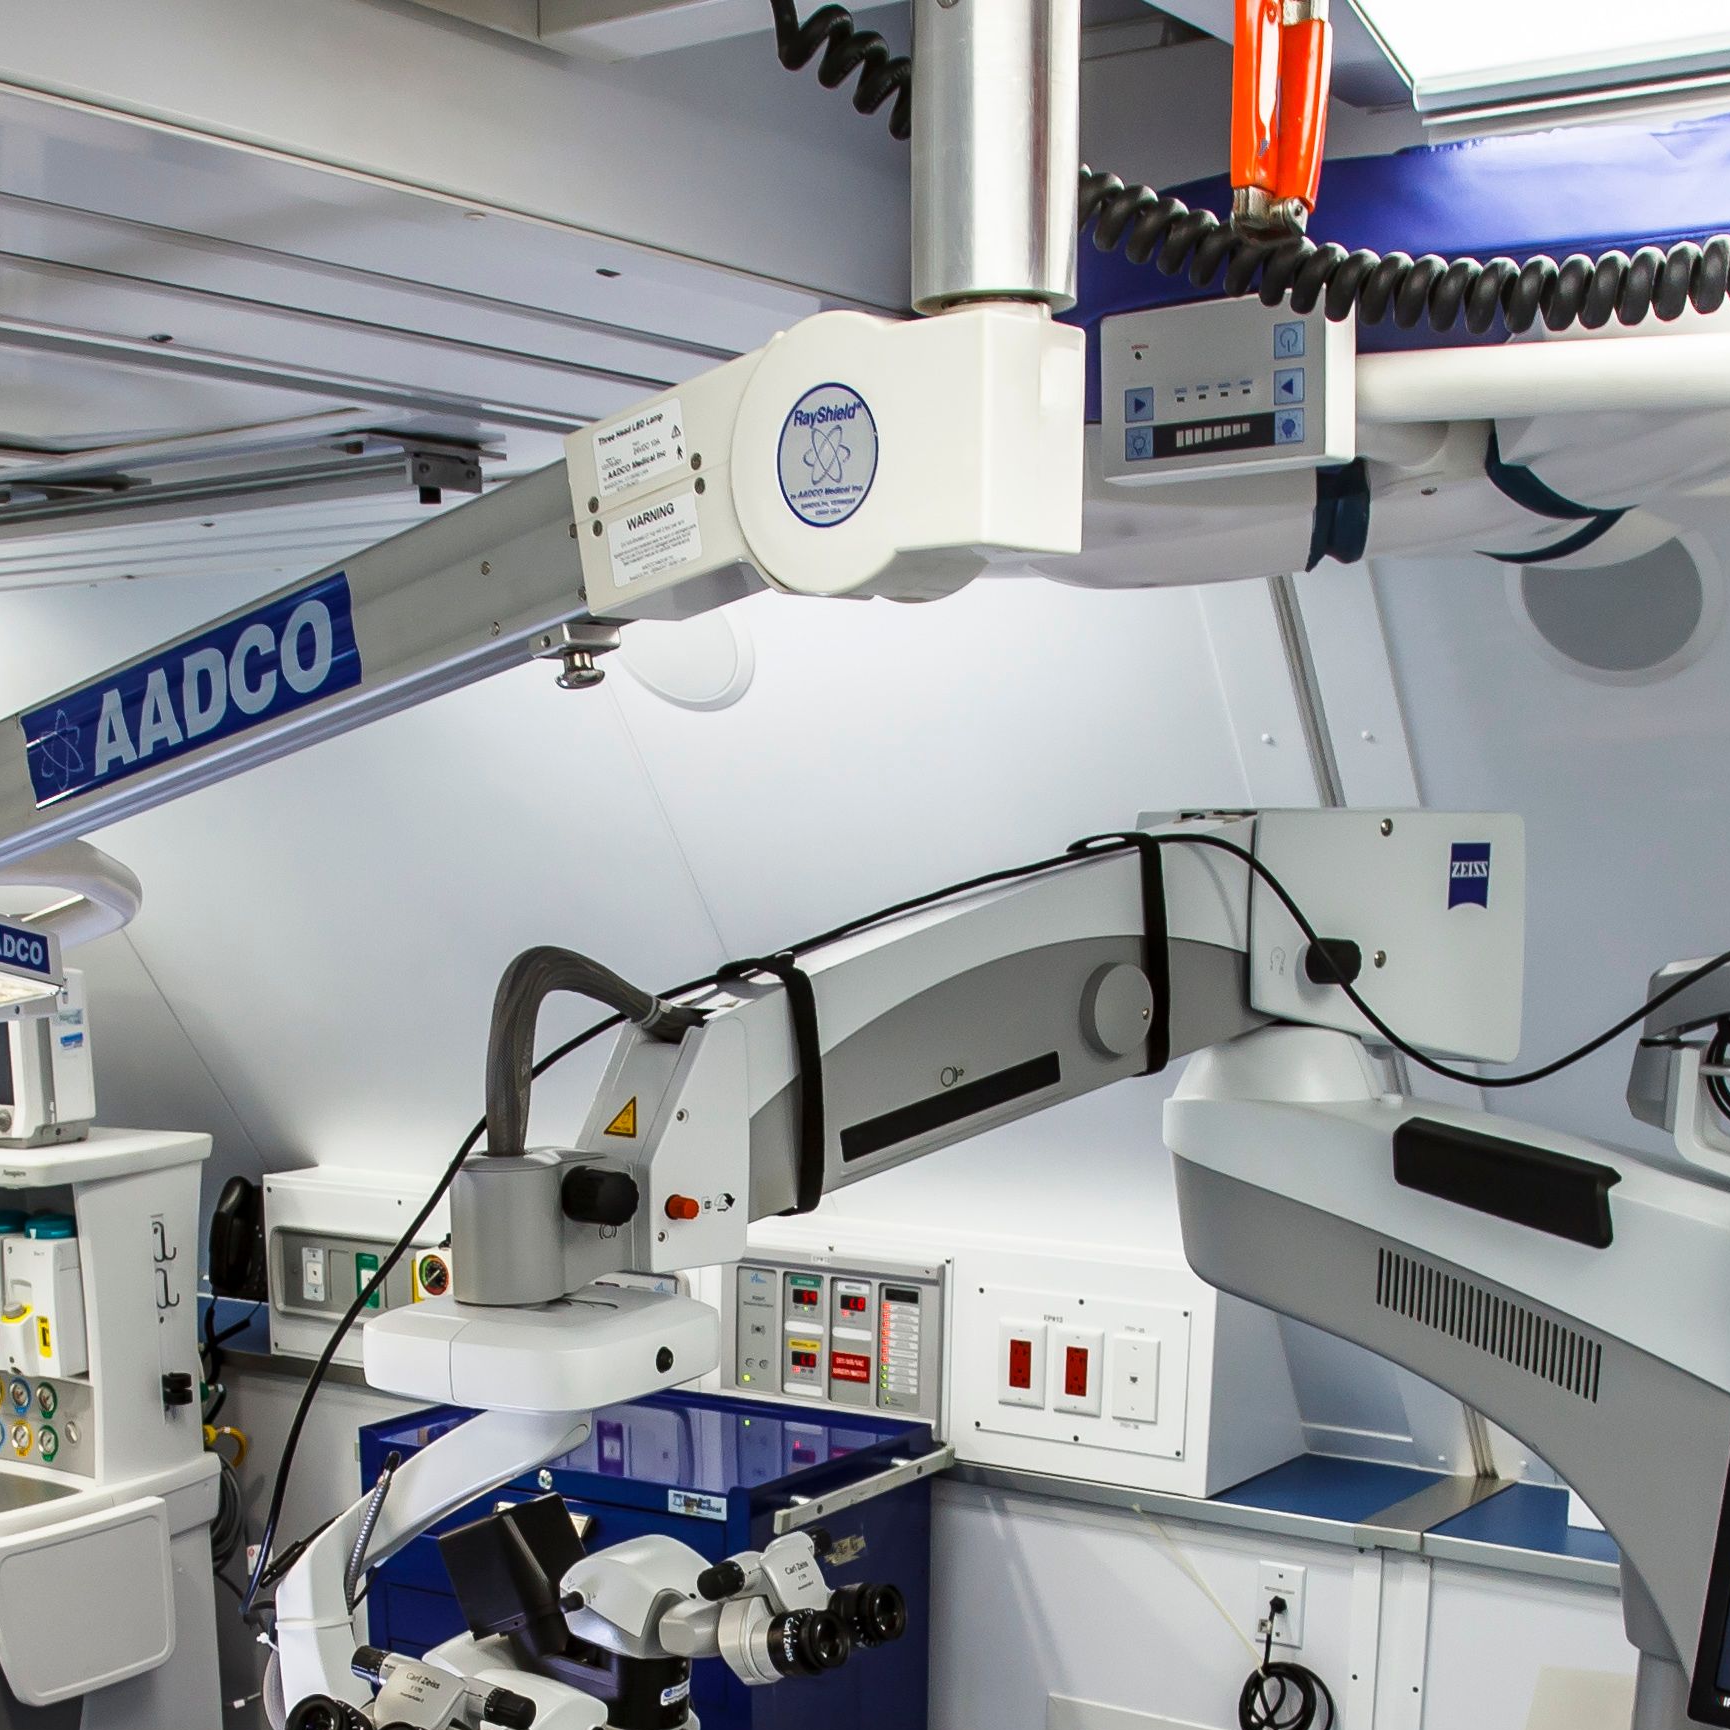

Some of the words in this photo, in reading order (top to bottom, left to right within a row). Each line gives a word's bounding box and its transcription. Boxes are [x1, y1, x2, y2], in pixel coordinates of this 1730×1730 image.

[793, 403, 856, 427] RayShield
[626, 502, 675, 531] WARNING
[93, 597, 335, 777] AADCO
[1452, 861, 1489, 878] ZEISS
[784, 1563, 797, 1576] Carl
[406, 1672, 422, 1684] Carl
[421, 1677, 441, 1690] Zeiss
